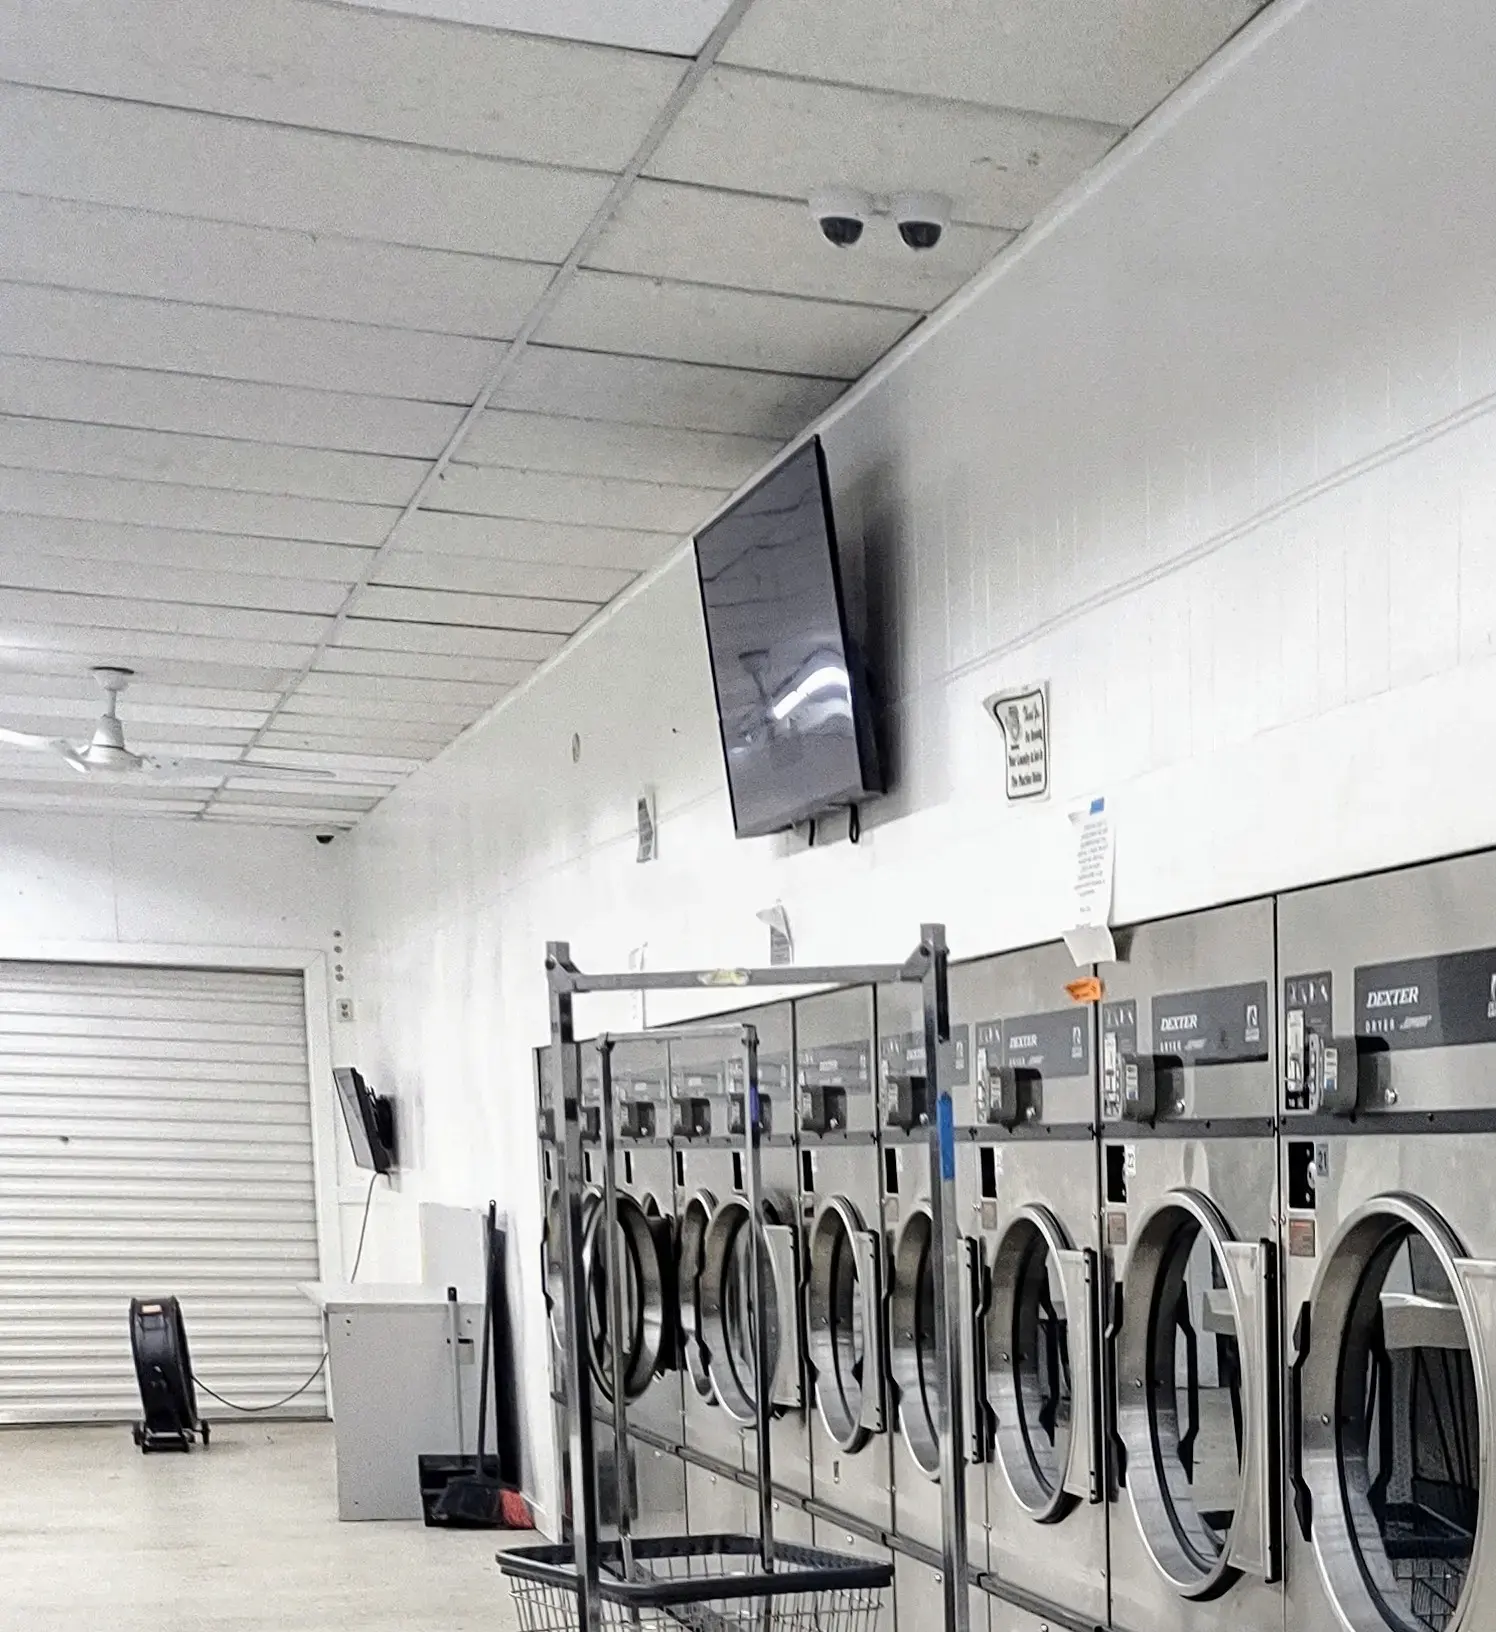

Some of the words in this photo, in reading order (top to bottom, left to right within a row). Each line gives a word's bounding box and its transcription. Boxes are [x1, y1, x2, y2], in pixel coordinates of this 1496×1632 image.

[1366, 986, 1419, 1008] DEXTER
[1160, 1013, 1198, 1032] DEXTER
[1009, 1033, 1038, 1049] DEXTER
